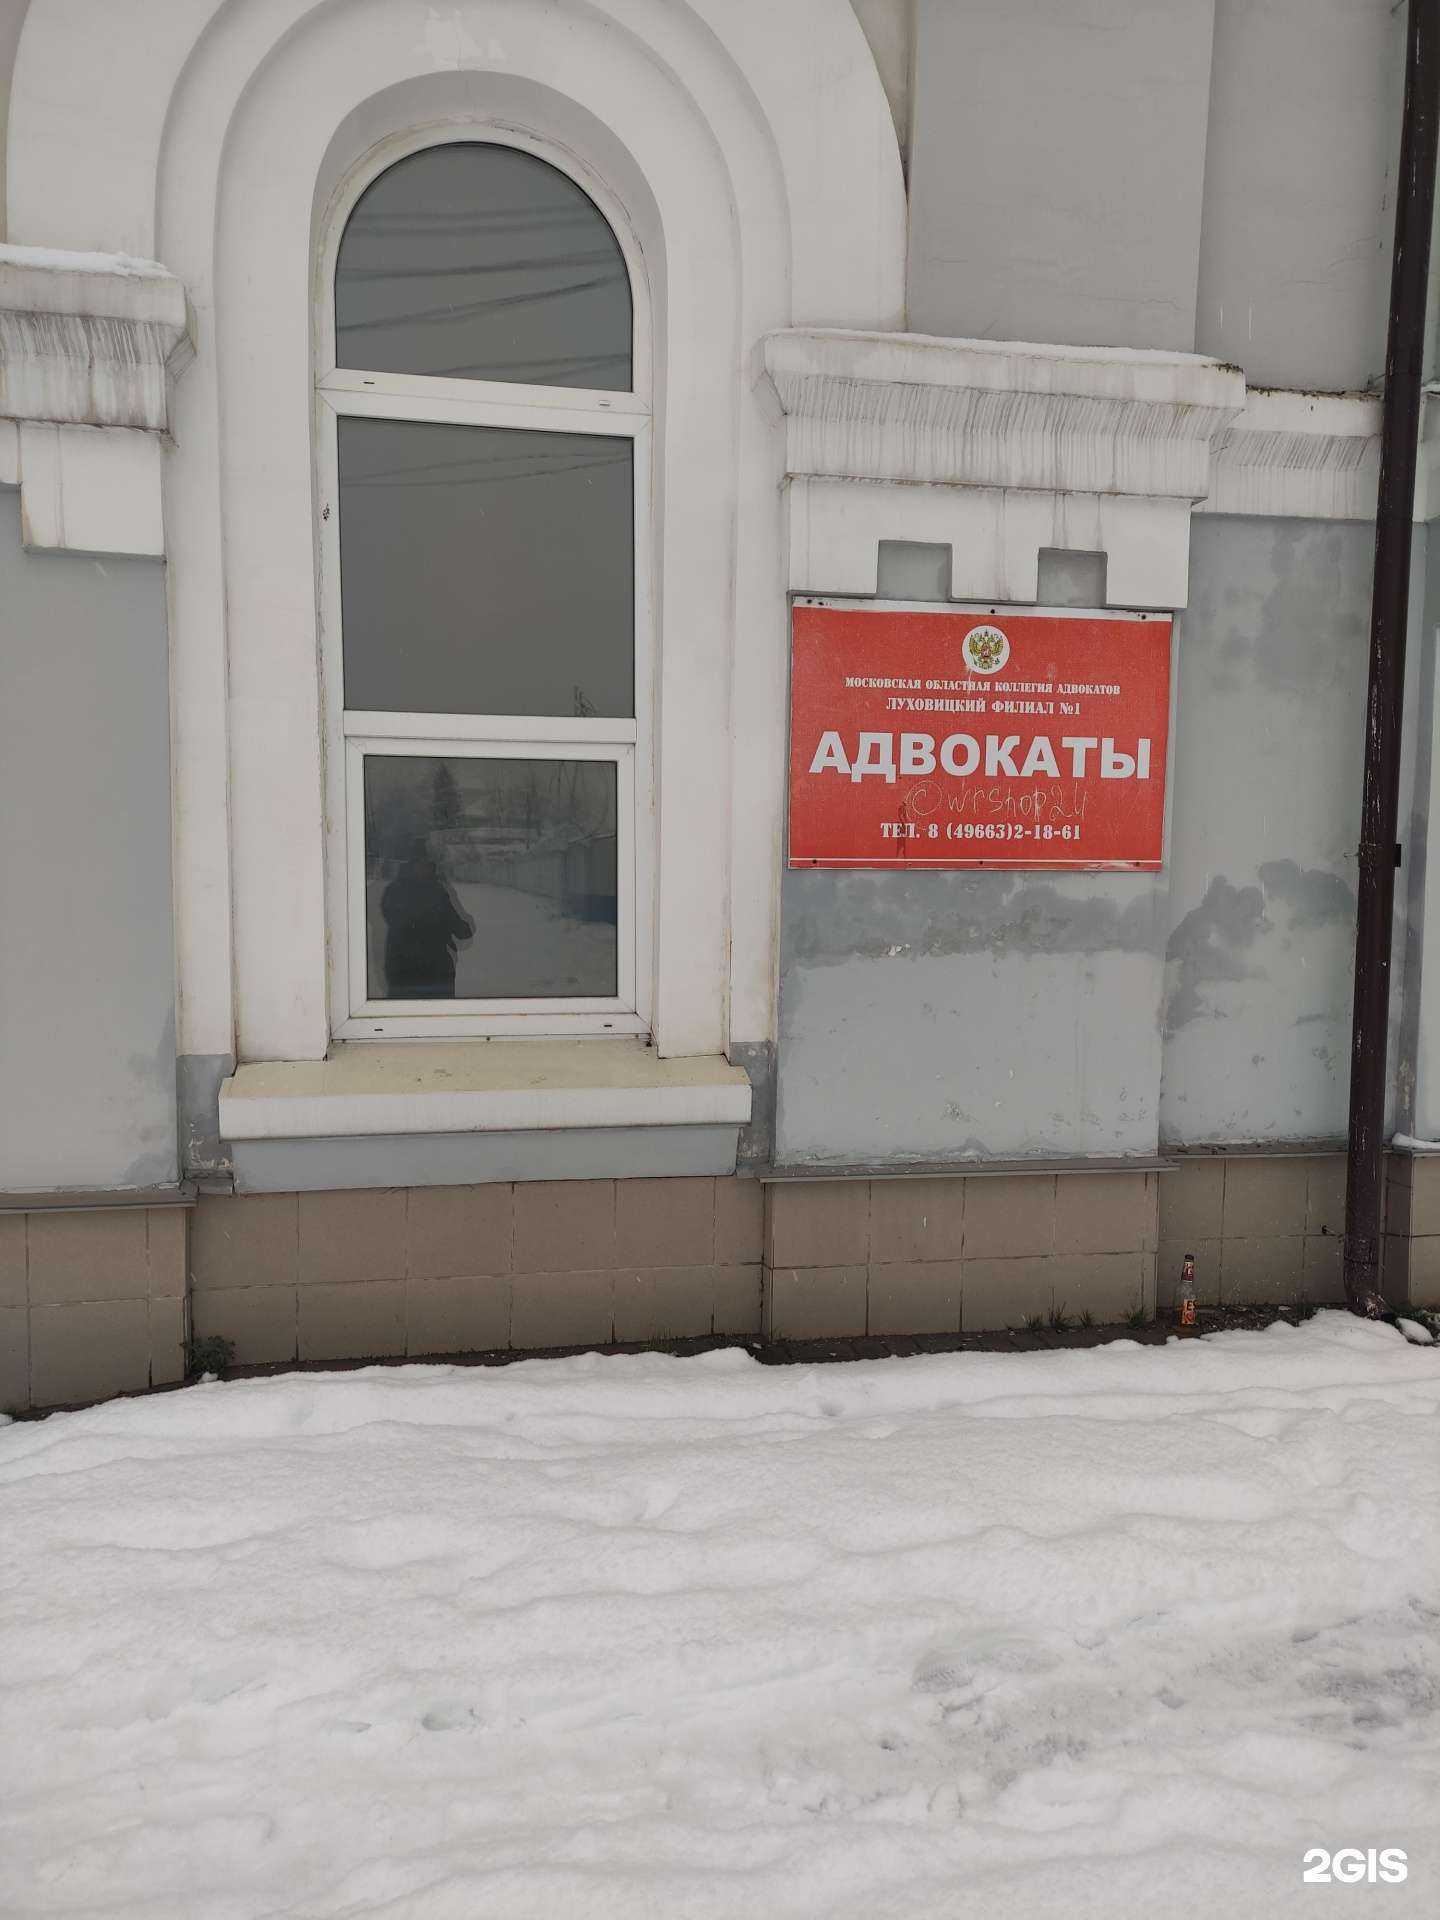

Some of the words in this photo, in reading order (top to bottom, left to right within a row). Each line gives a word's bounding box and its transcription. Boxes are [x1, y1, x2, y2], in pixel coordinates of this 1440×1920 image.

[845, 677, 921, 690] МОСКОВСКАЯ
[925, 679, 991, 691] ОБЛАСТНАЯ
[995, 681, 1053, 693] КОЛЛЕГИЯ
[1056, 683, 1121, 695] АДВОКАТОВ
[886, 697, 986, 713] ЛУХОВИЦКИЙ
[991, 700, 1054, 714] ФИЛИАЛ
[1059, 702, 1081, 715] №1
[809, 731, 1151, 783] АДВОКАТЫ
[881, 823, 920, 839] ТЕЛ.
[927, 824, 939, 839] 8
[946, 823, 1081, 840] (49663)2-18-61
